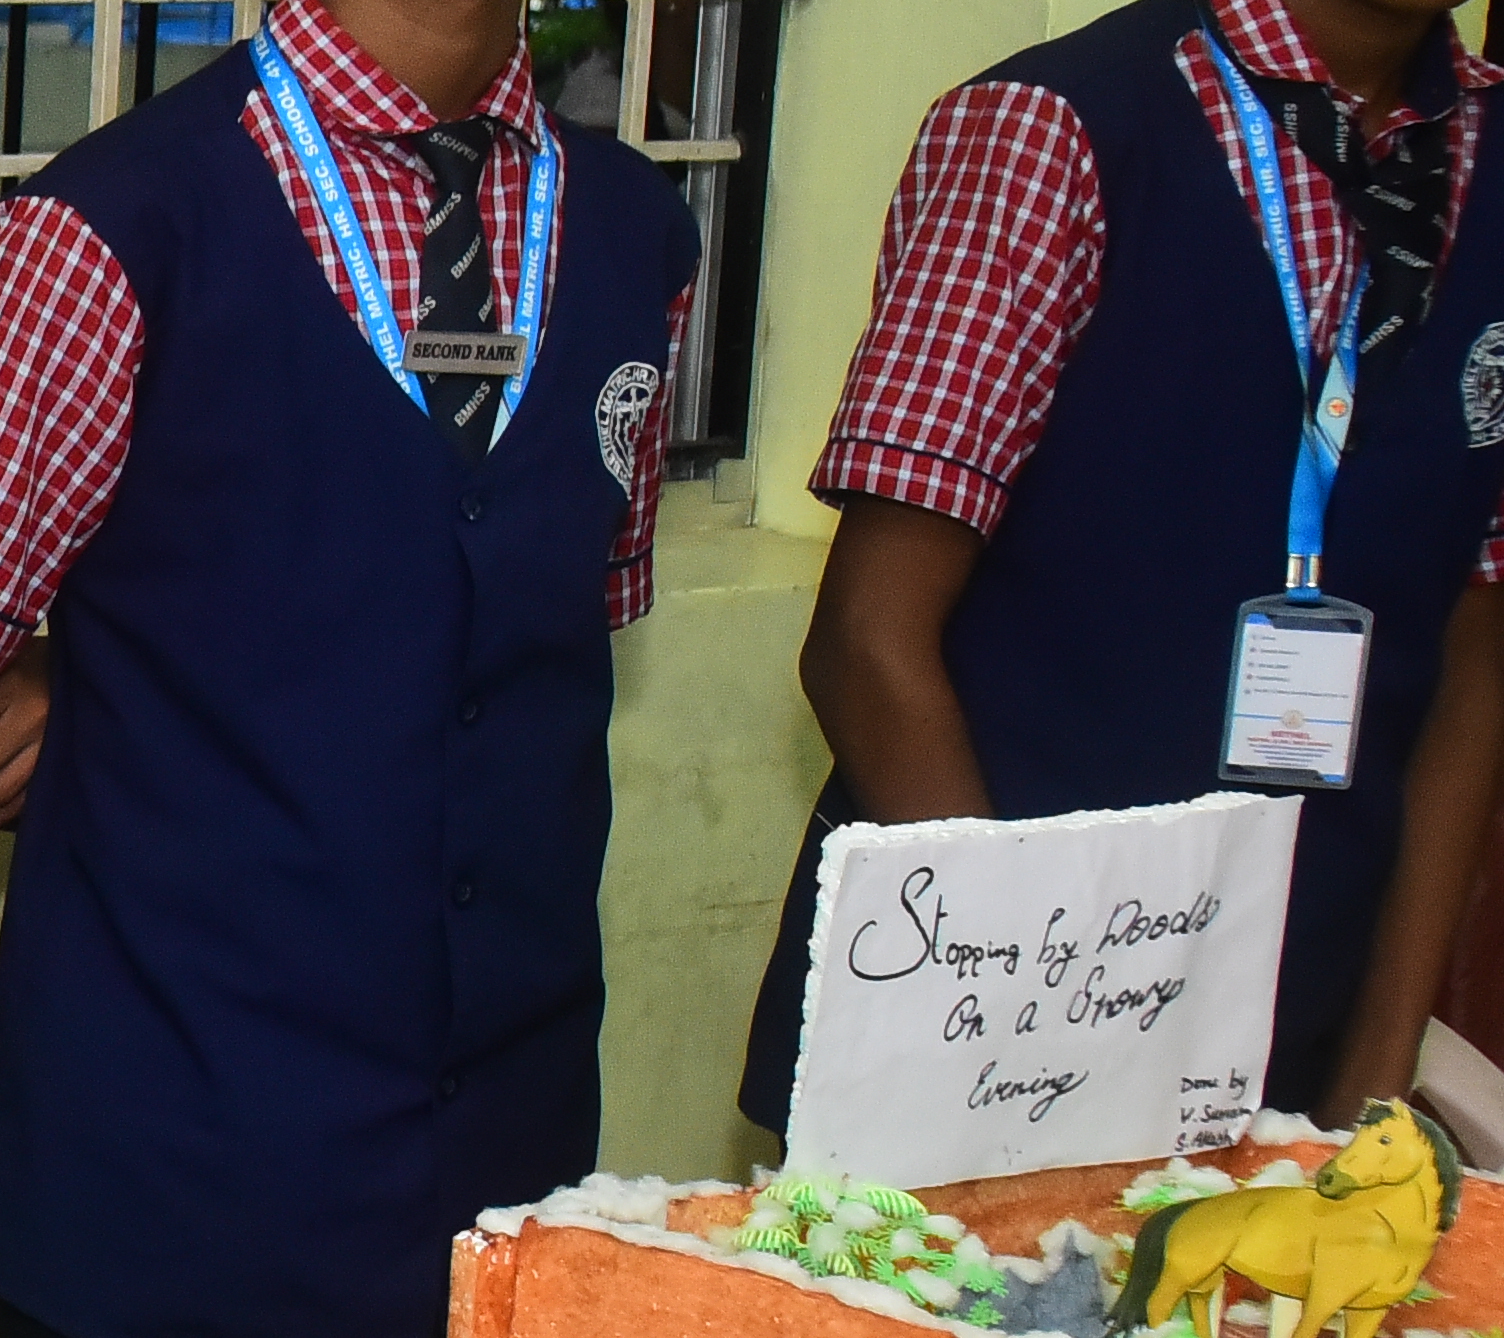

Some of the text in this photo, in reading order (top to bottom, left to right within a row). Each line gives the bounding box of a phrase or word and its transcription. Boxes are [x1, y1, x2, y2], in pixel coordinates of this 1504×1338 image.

[314, 158, 340, 203] SEC.
[330, 204, 354, 241] HR.
[531, 208, 545, 240] HR.
[412, 343, 518, 362] SECOND RANK
[453, 380, 491, 428] BMHSS
[849, 866, 1021, 983] Stopping
[1037, 907, 1080, 988] by
[943, 994, 986, 1042] On
[967, 1060, 1090, 1123] Evening
